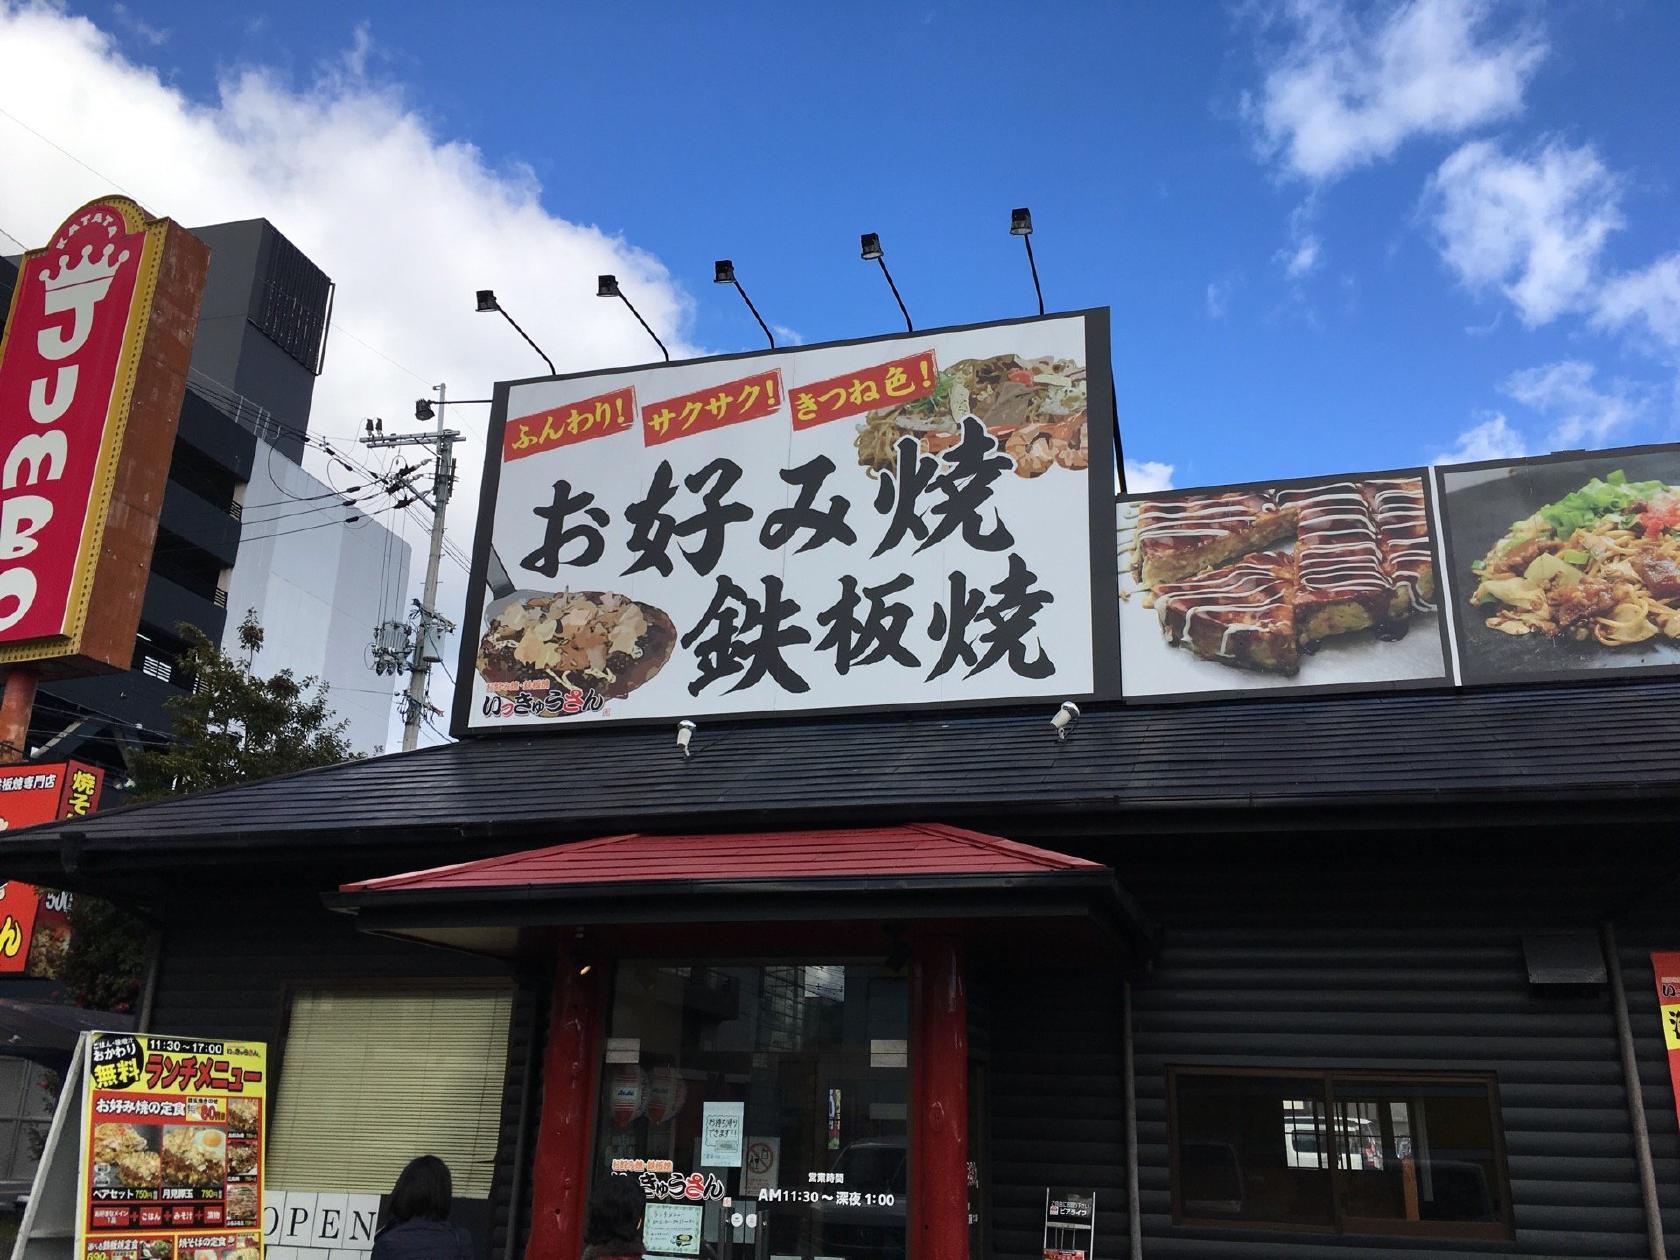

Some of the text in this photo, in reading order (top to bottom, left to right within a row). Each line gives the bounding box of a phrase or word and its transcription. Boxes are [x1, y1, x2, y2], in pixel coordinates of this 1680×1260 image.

[55, 212, 118, 250] KATATA
[647, 379, 777, 434] サクサク!
[796, 360, 933, 422] きつね色!
[511, 398, 628, 450] ふんわり!
[520, 414, 1016, 578] お好み焼
[681, 552, 1056, 697] 鉄板焼
[482, 688, 604, 718] いっきゅうさん
[0, 773, 57, 792] 板焼専門店
[66, 770, 96, 819] 焼そ
[93, 1044, 137, 1062] おかわり
[94, 1057, 141, 1088] 無料
[145, 1054, 262, 1092] ランチメニュー
[96, 1098, 186, 1118] お好み焼の定食
[808, 1172, 844, 1184] 営業時間
[264, 1206, 377, 1241] OPEN
